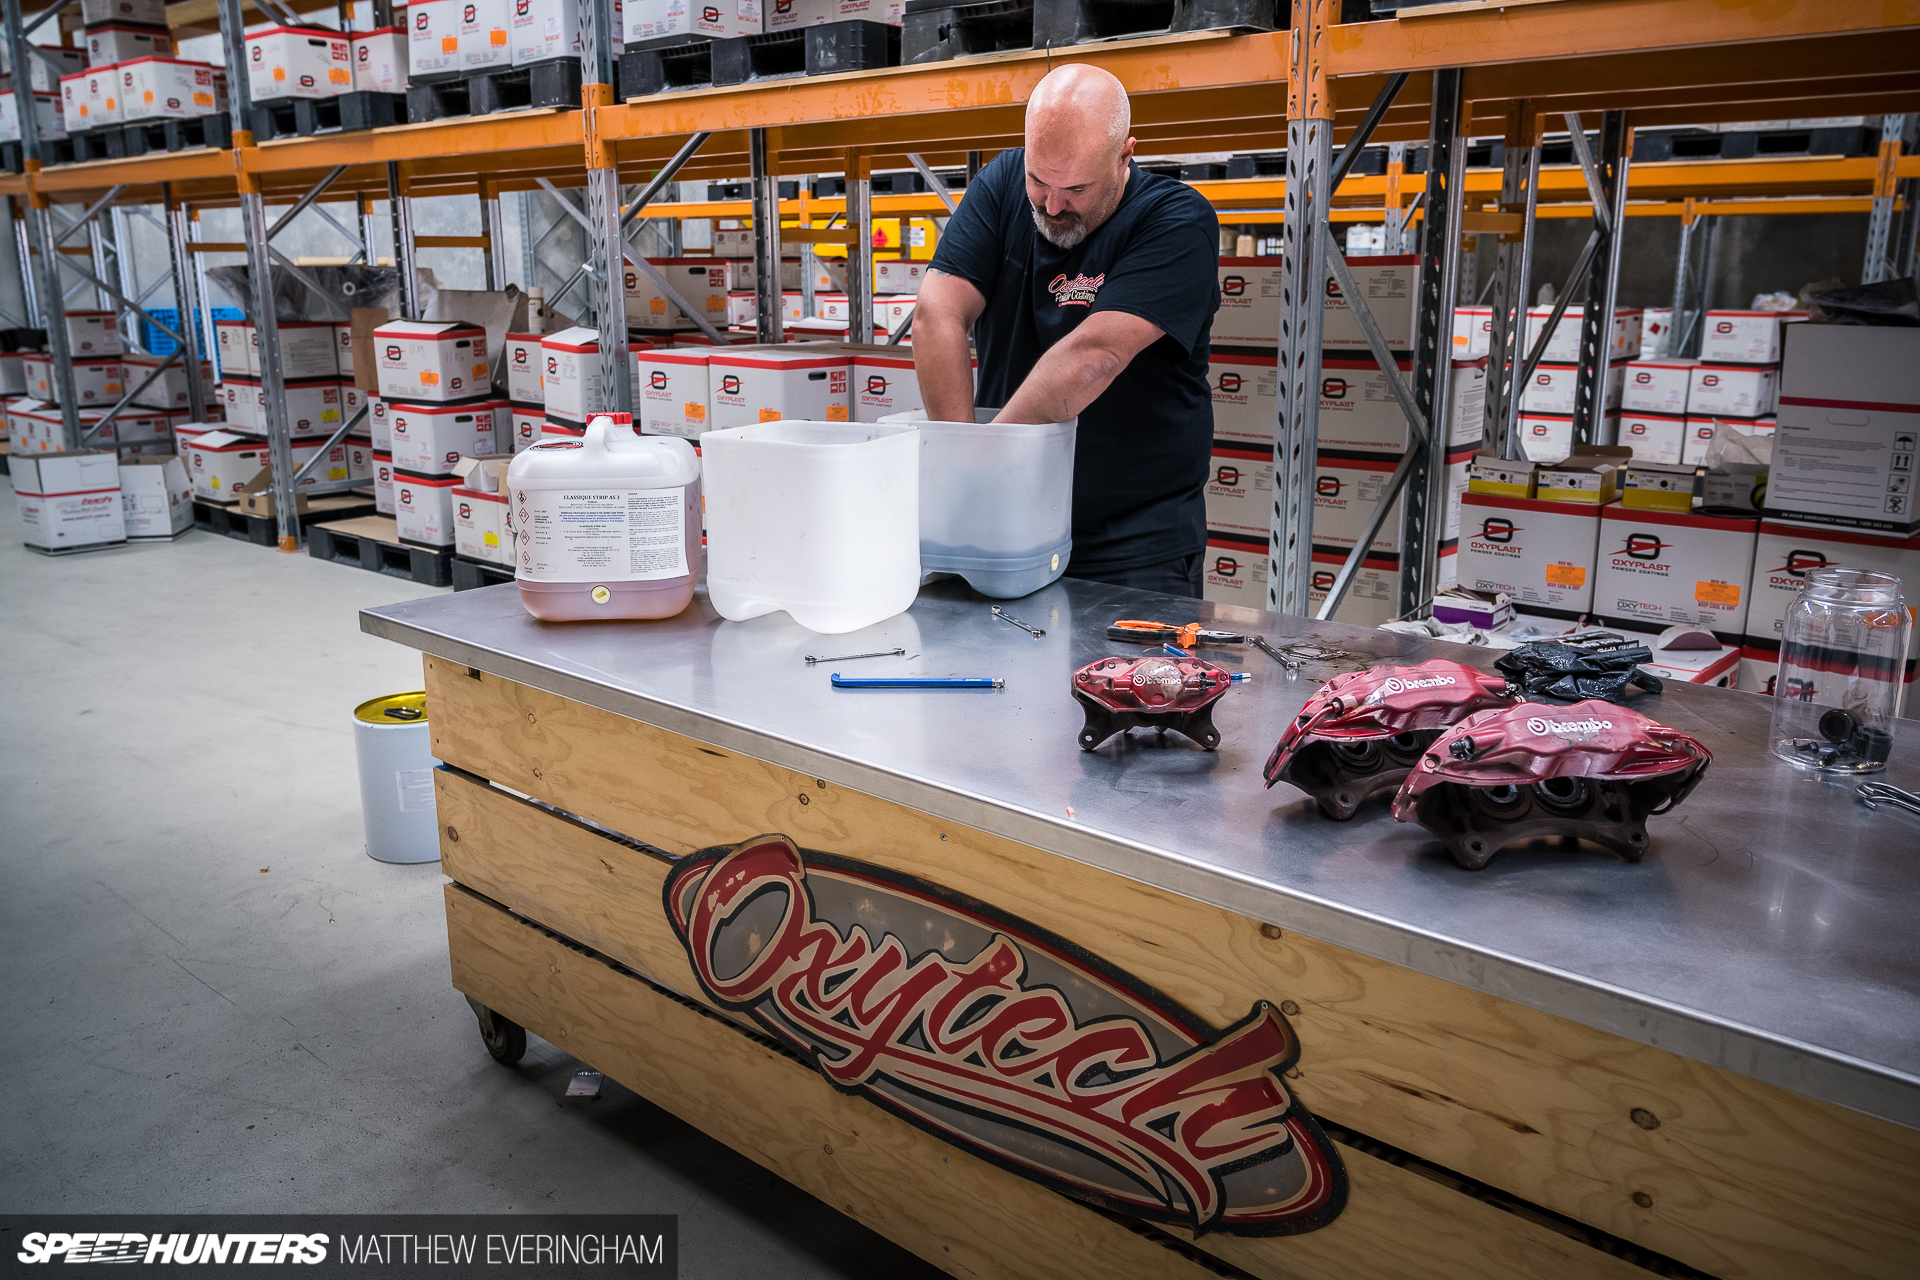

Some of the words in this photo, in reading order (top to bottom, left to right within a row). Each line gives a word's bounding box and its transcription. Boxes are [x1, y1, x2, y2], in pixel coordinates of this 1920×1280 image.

[717, 395, 746, 403] OXYPLAST
[861, 395, 893, 404] OXYPLAST
[1471, 542, 1523, 553] OXYPLAST
[1612, 559, 1671, 571] OXYPLAST
[1770, 576, 1804, 586] OXYP
[1475, 582, 1515, 591] OXYTECH
[1617, 601, 1662, 611] OXYTECH
[1146, 675, 1182, 685] brembo
[1402, 675, 1456, 690] brembo
[1548, 718, 1613, 733] brembo
[688, 833, 1300, 1222] Oxytech
